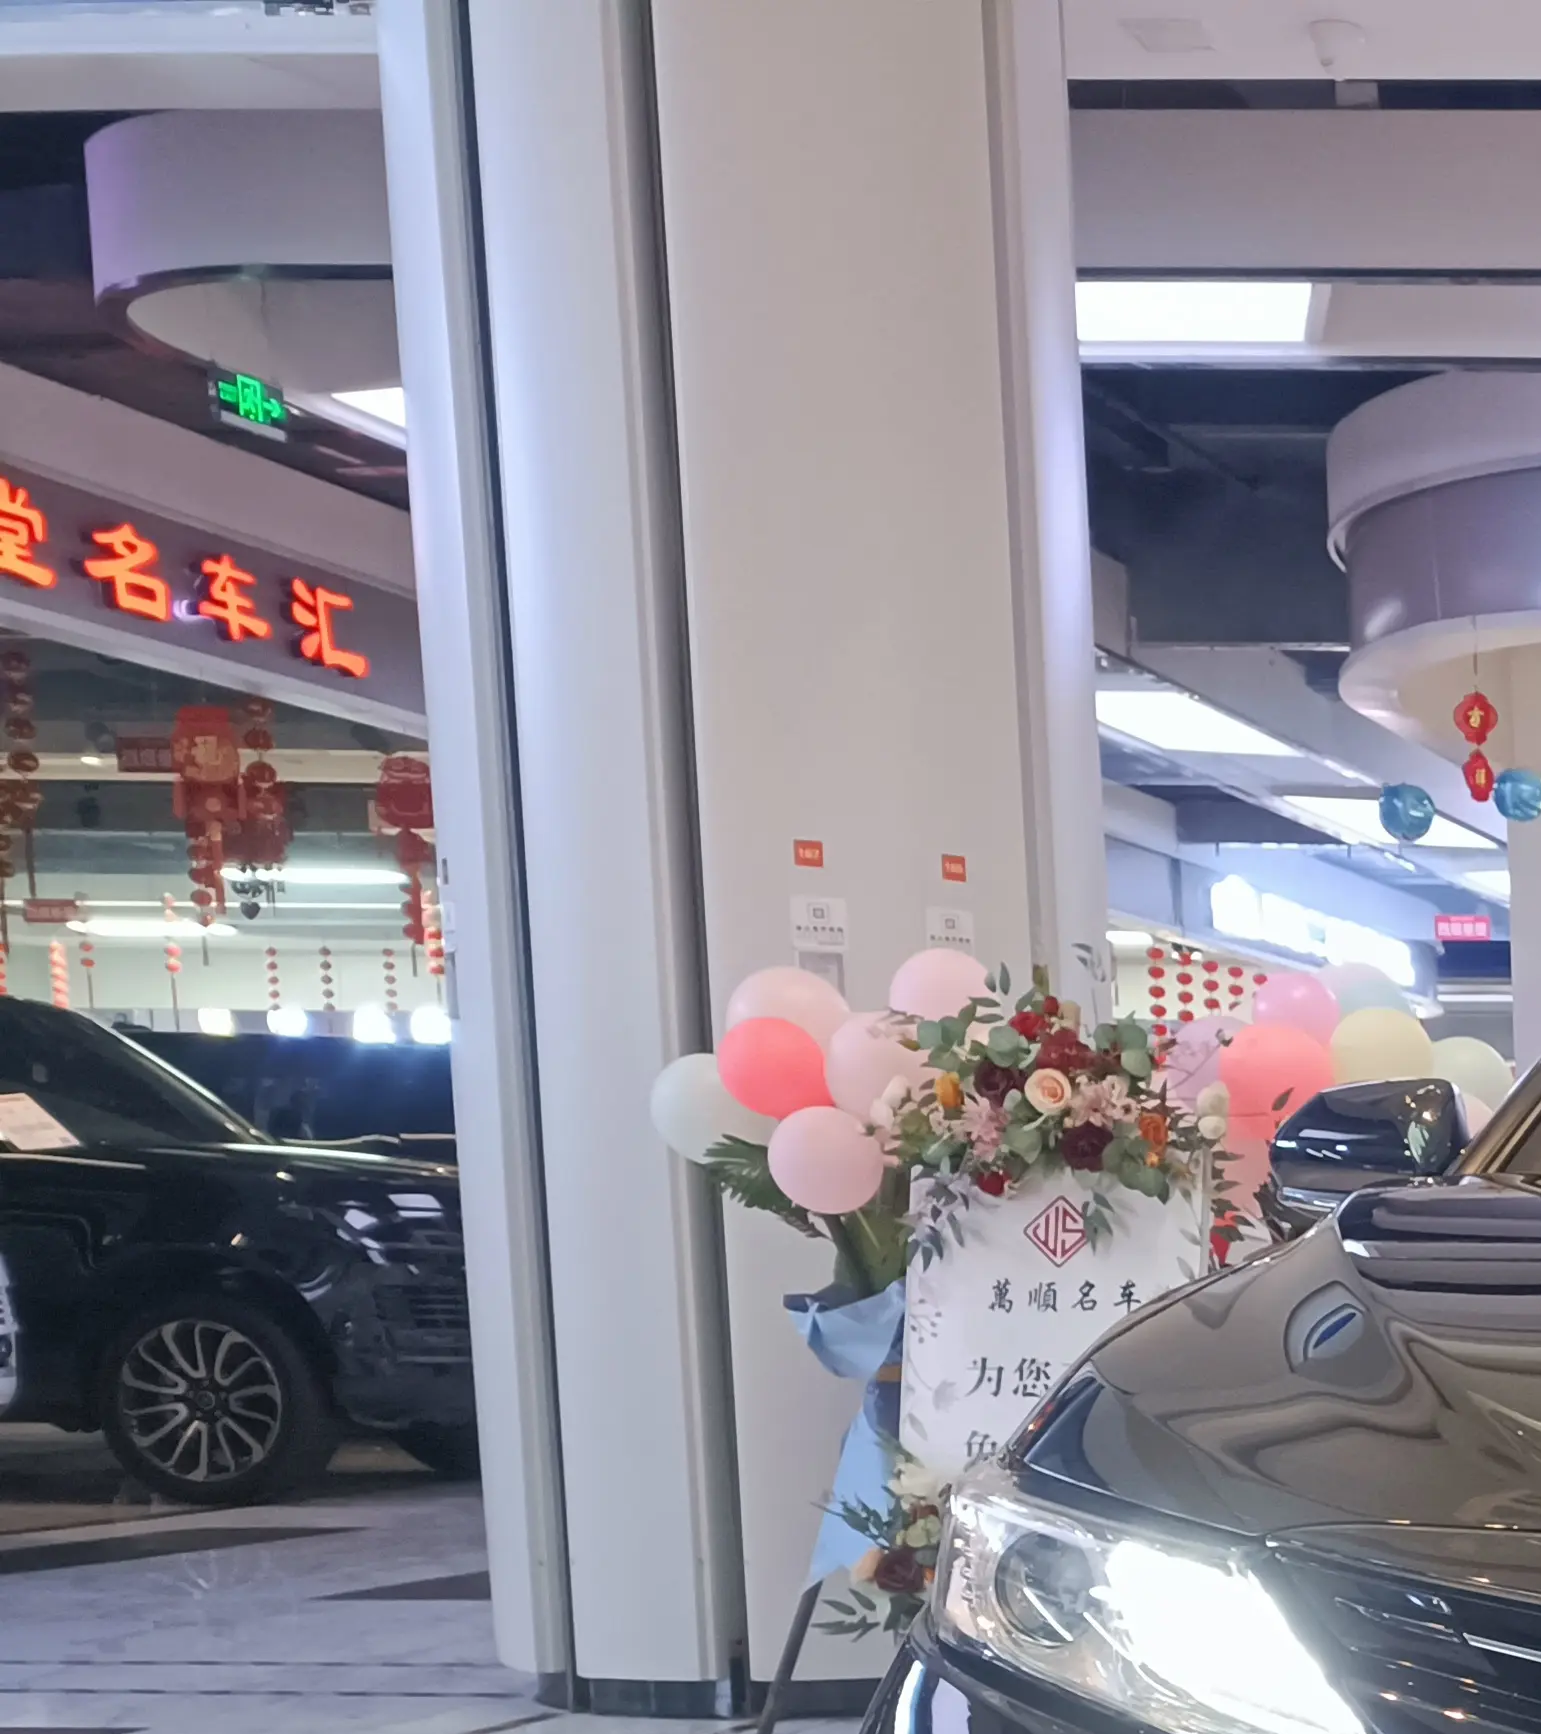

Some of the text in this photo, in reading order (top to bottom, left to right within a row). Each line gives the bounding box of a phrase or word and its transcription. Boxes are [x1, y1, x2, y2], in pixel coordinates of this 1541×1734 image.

[988, 1278, 1142, 1313] 萬順名车
[964, 1356, 1071, 1399] 为您
